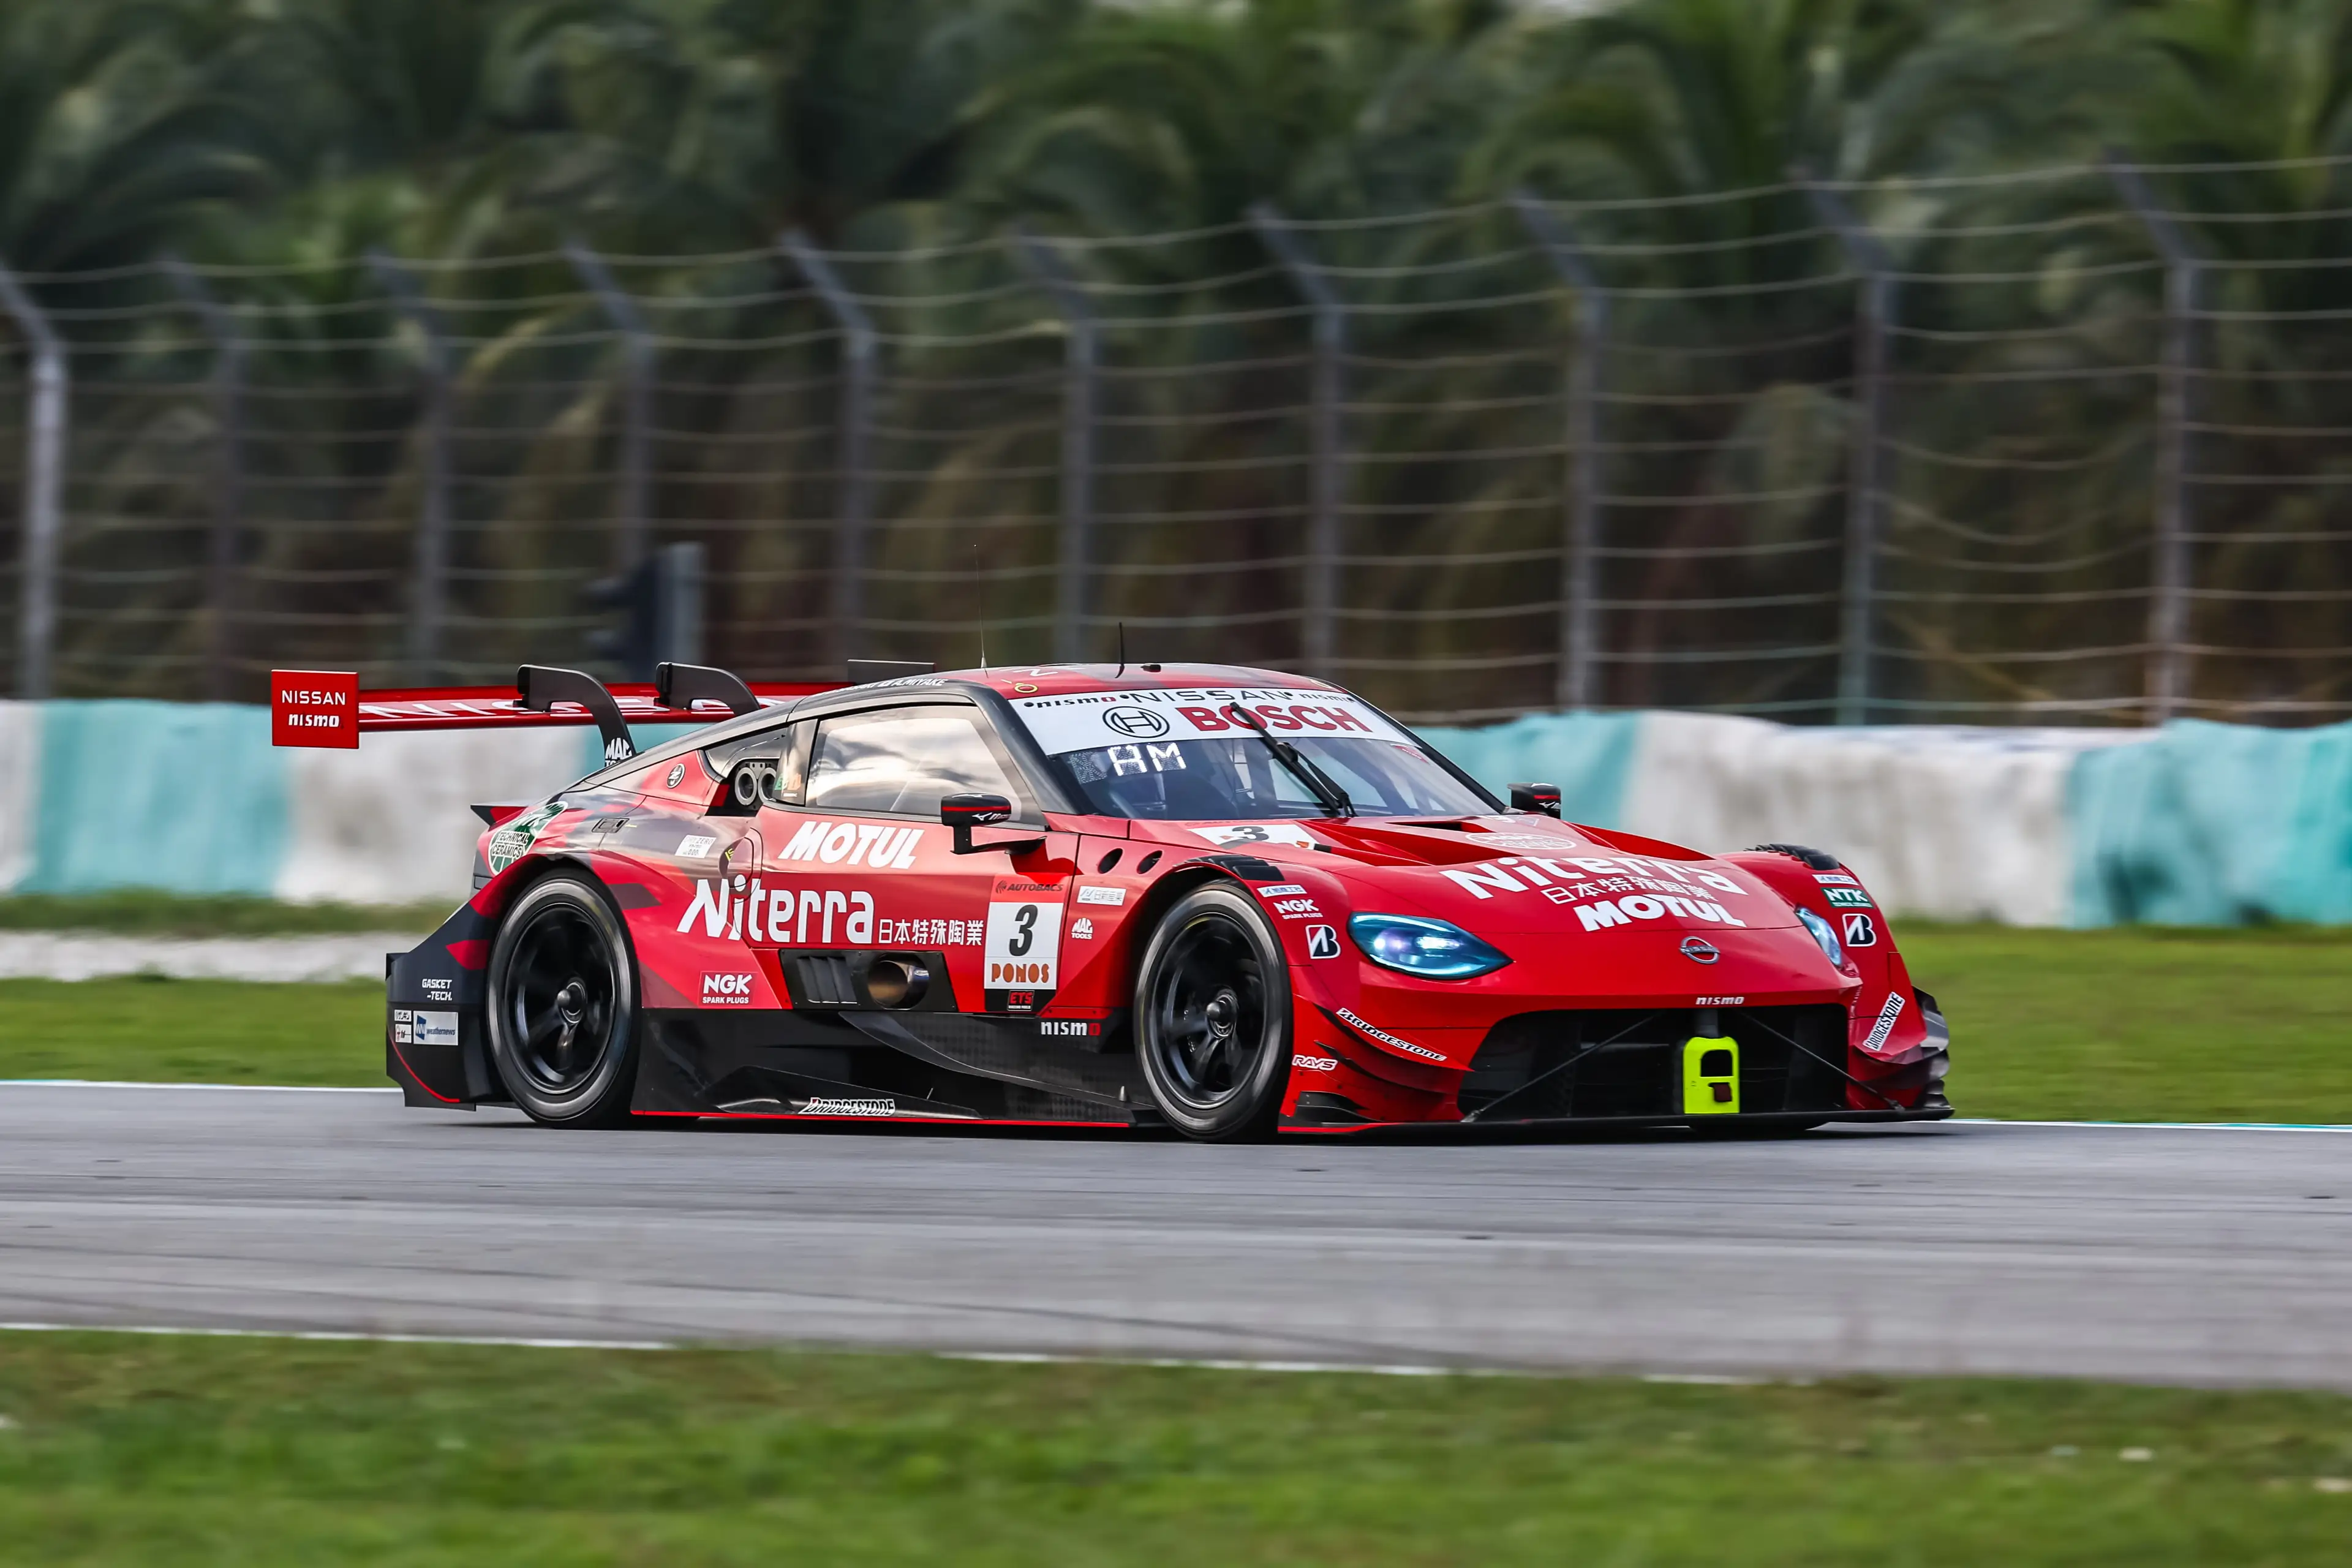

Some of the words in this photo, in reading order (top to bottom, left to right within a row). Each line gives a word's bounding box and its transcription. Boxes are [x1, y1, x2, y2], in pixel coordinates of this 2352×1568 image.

[282, 690, 345, 705] NISSAN
[1037, 696, 1116, 708] nismo
[1129, 690, 1292, 703] NISSAN
[288, 714, 340, 728] nismo
[1175, 705, 1373, 733] BOSCH
[605, 737, 633, 760] MAC
[499, 832, 529, 844] TECHNICAL
[777, 821, 925, 869] MOTUL
[492, 845, 522, 858] CERAMICS
[1439, 856, 1748, 900] Niterra
[1540, 875, 1718, 905] 日本特殊陶業
[1823, 888, 1869, 902] NTK
[677, 874, 875, 944] Niterra
[1272, 899, 1319, 914] NGK
[1573, 895, 1747, 932] MOTUL
[878, 919, 984, 945] 日本特殊陶業
[1009, 904, 1038, 957] 3
[1071, 918, 1093, 934] MAC
[991, 963, 1050, 984] PONOS
[421, 978, 453, 989] GASKET
[703, 974, 753, 995] NGK
[427, 990, 453, 1001] -TECH.
[1010, 992, 1033, 1005] ETS
[1695, 996, 1745, 1005] nismo
[427, 1027, 456, 1036] weathernews
[1041, 1022, 1101, 1036] nismo
[1338, 1009, 1445, 1061] BRIDGESTONE
[1293, 1056, 1337, 1070] RAYS
[800, 1098, 895, 1115] BRIDGESTONE
